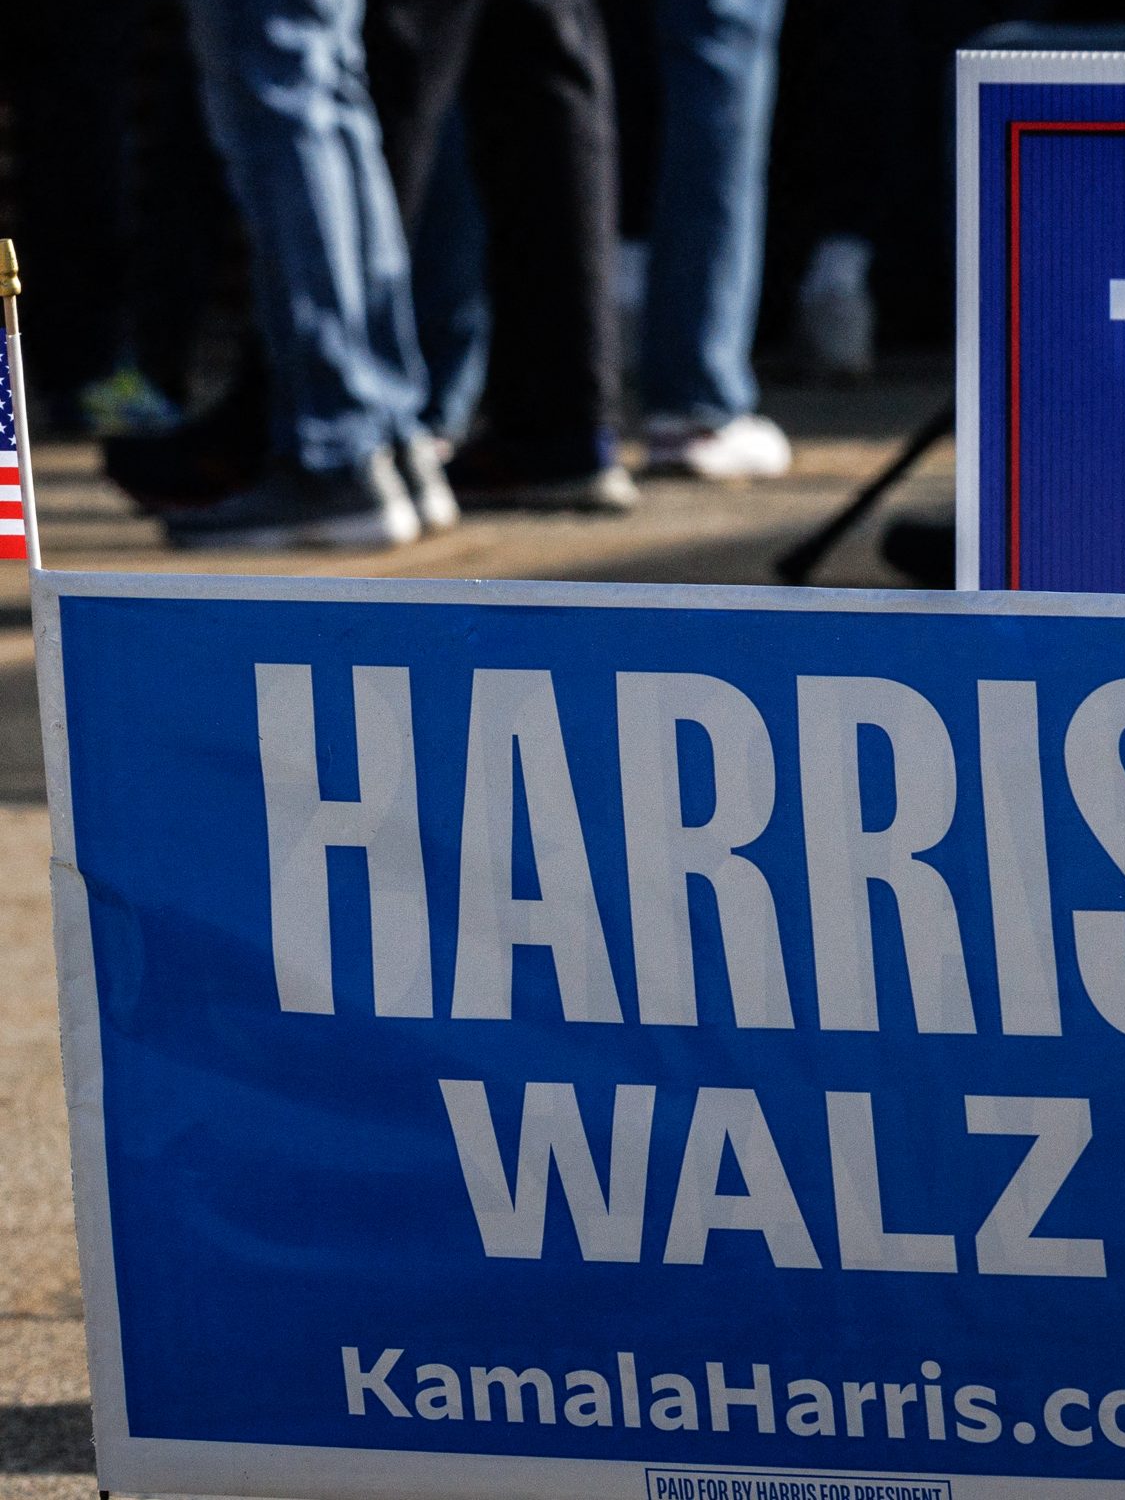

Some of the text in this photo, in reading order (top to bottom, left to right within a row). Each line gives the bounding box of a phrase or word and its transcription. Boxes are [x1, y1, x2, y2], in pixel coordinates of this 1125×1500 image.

[439, 1079, 1107, 1278] WALZ
[656, 1476, 695, 1500] PAID
[697, 1478, 728, 1500] FOR
[731, 1480, 753, 1500] BY
[756, 1481, 817, 1500] HARRIS
[819, 1483, 851, 1500] FOR
